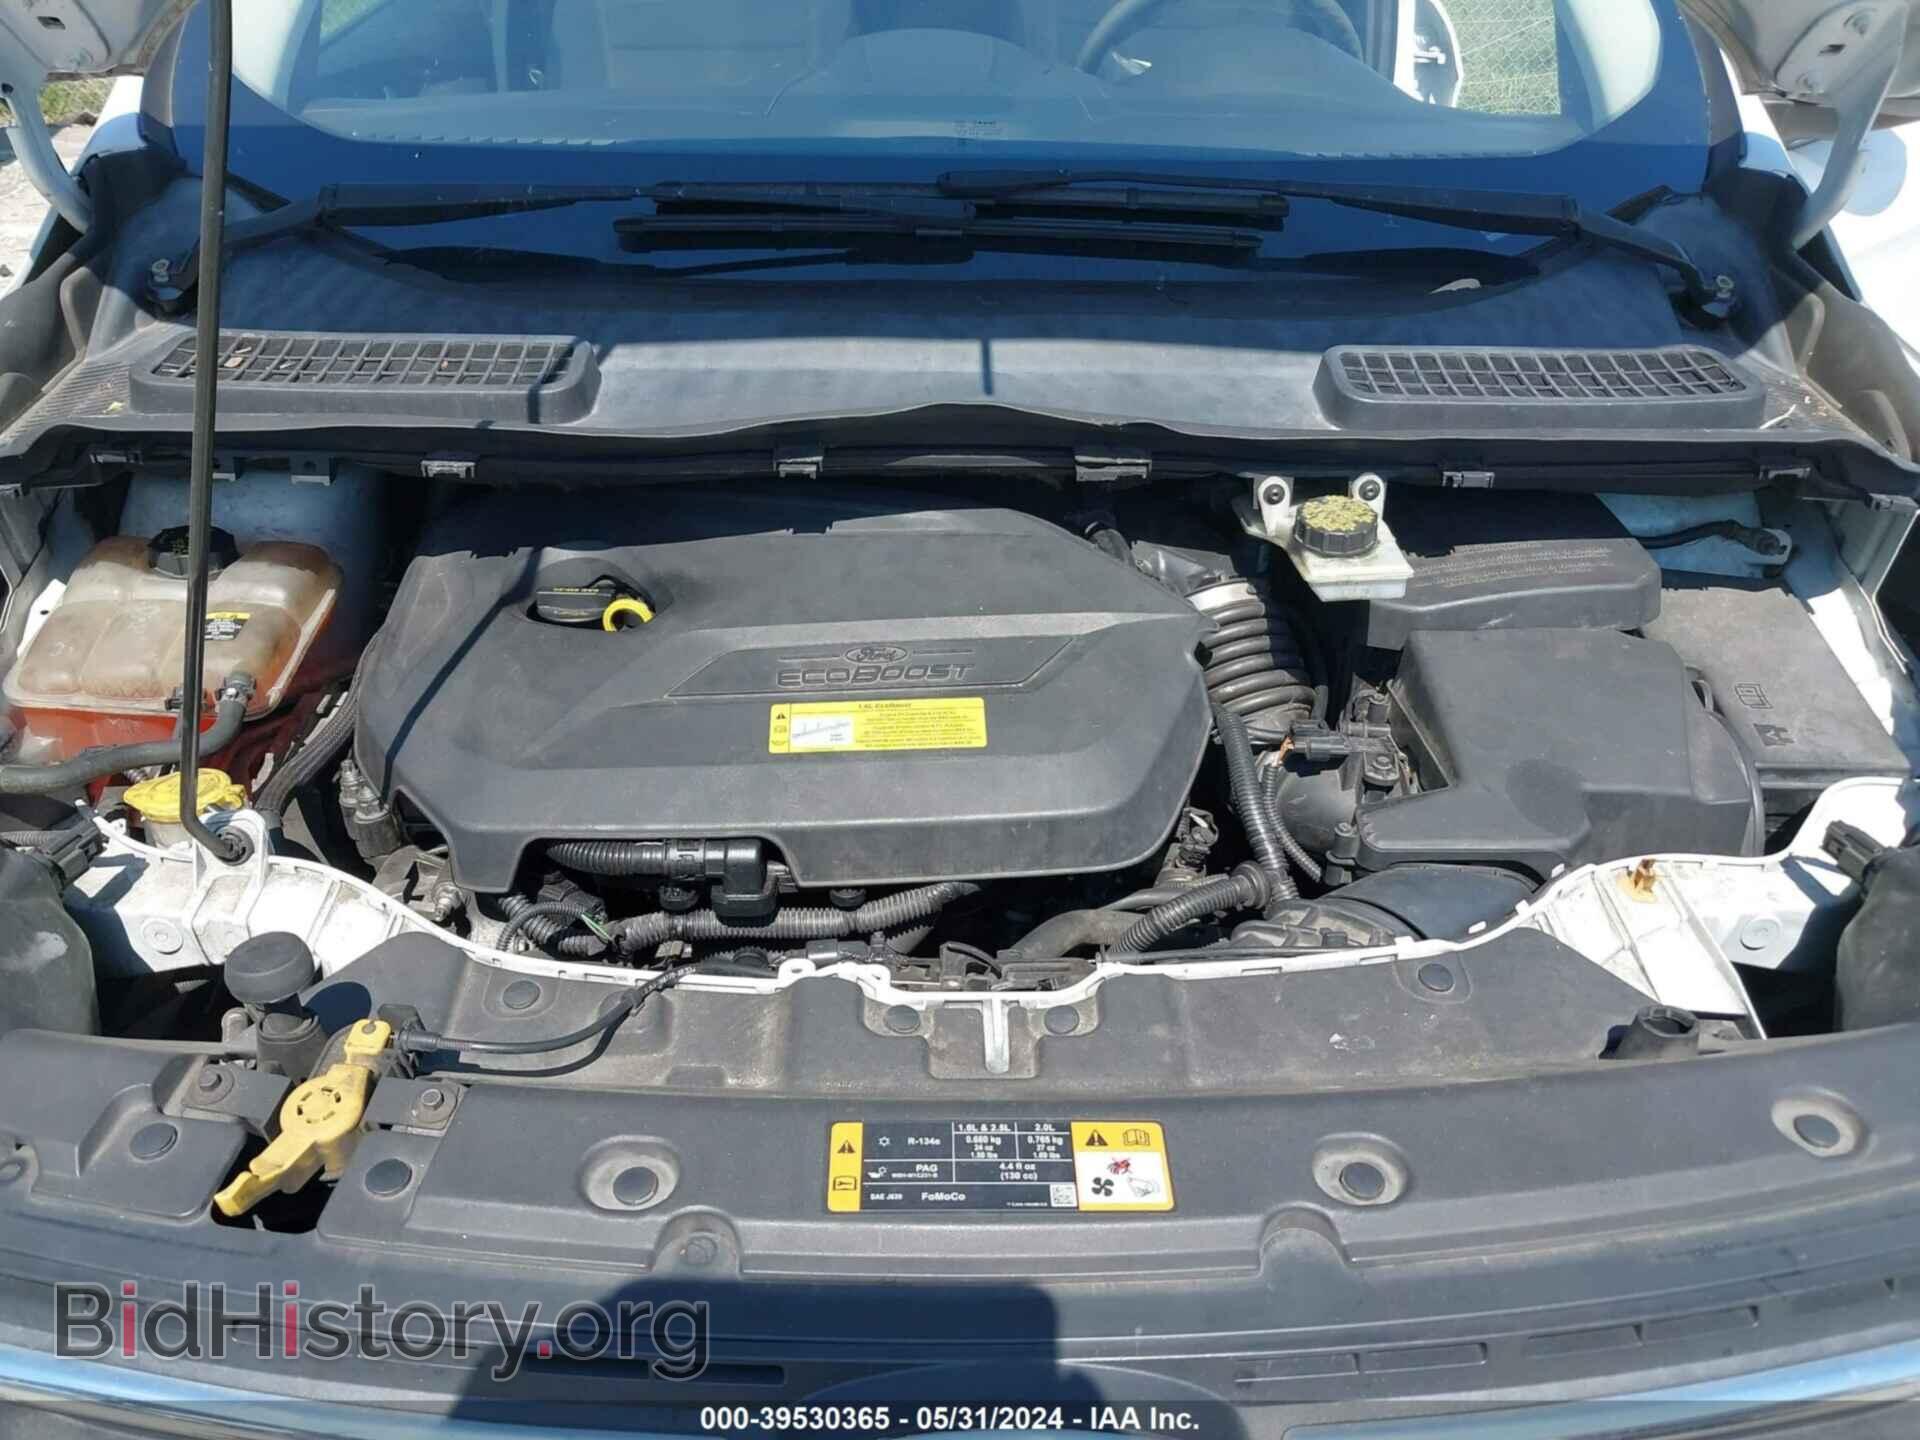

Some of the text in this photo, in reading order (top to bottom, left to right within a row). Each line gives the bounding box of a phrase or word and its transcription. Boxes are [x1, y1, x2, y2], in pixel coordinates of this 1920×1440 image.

[856, 647, 897, 662] Ford
[1035, 1123, 1056, 1132] 2.0L
[907, 1137, 941, 1145] R-134a
[990, 1135, 1001, 1146] kg
[1052, 1135, 1063, 1146] kg
[915, 1163, 938, 1172] PAG
[999, 1162, 1014, 1170] 4.4
[921, 1191, 966, 1201] FoMoCo
